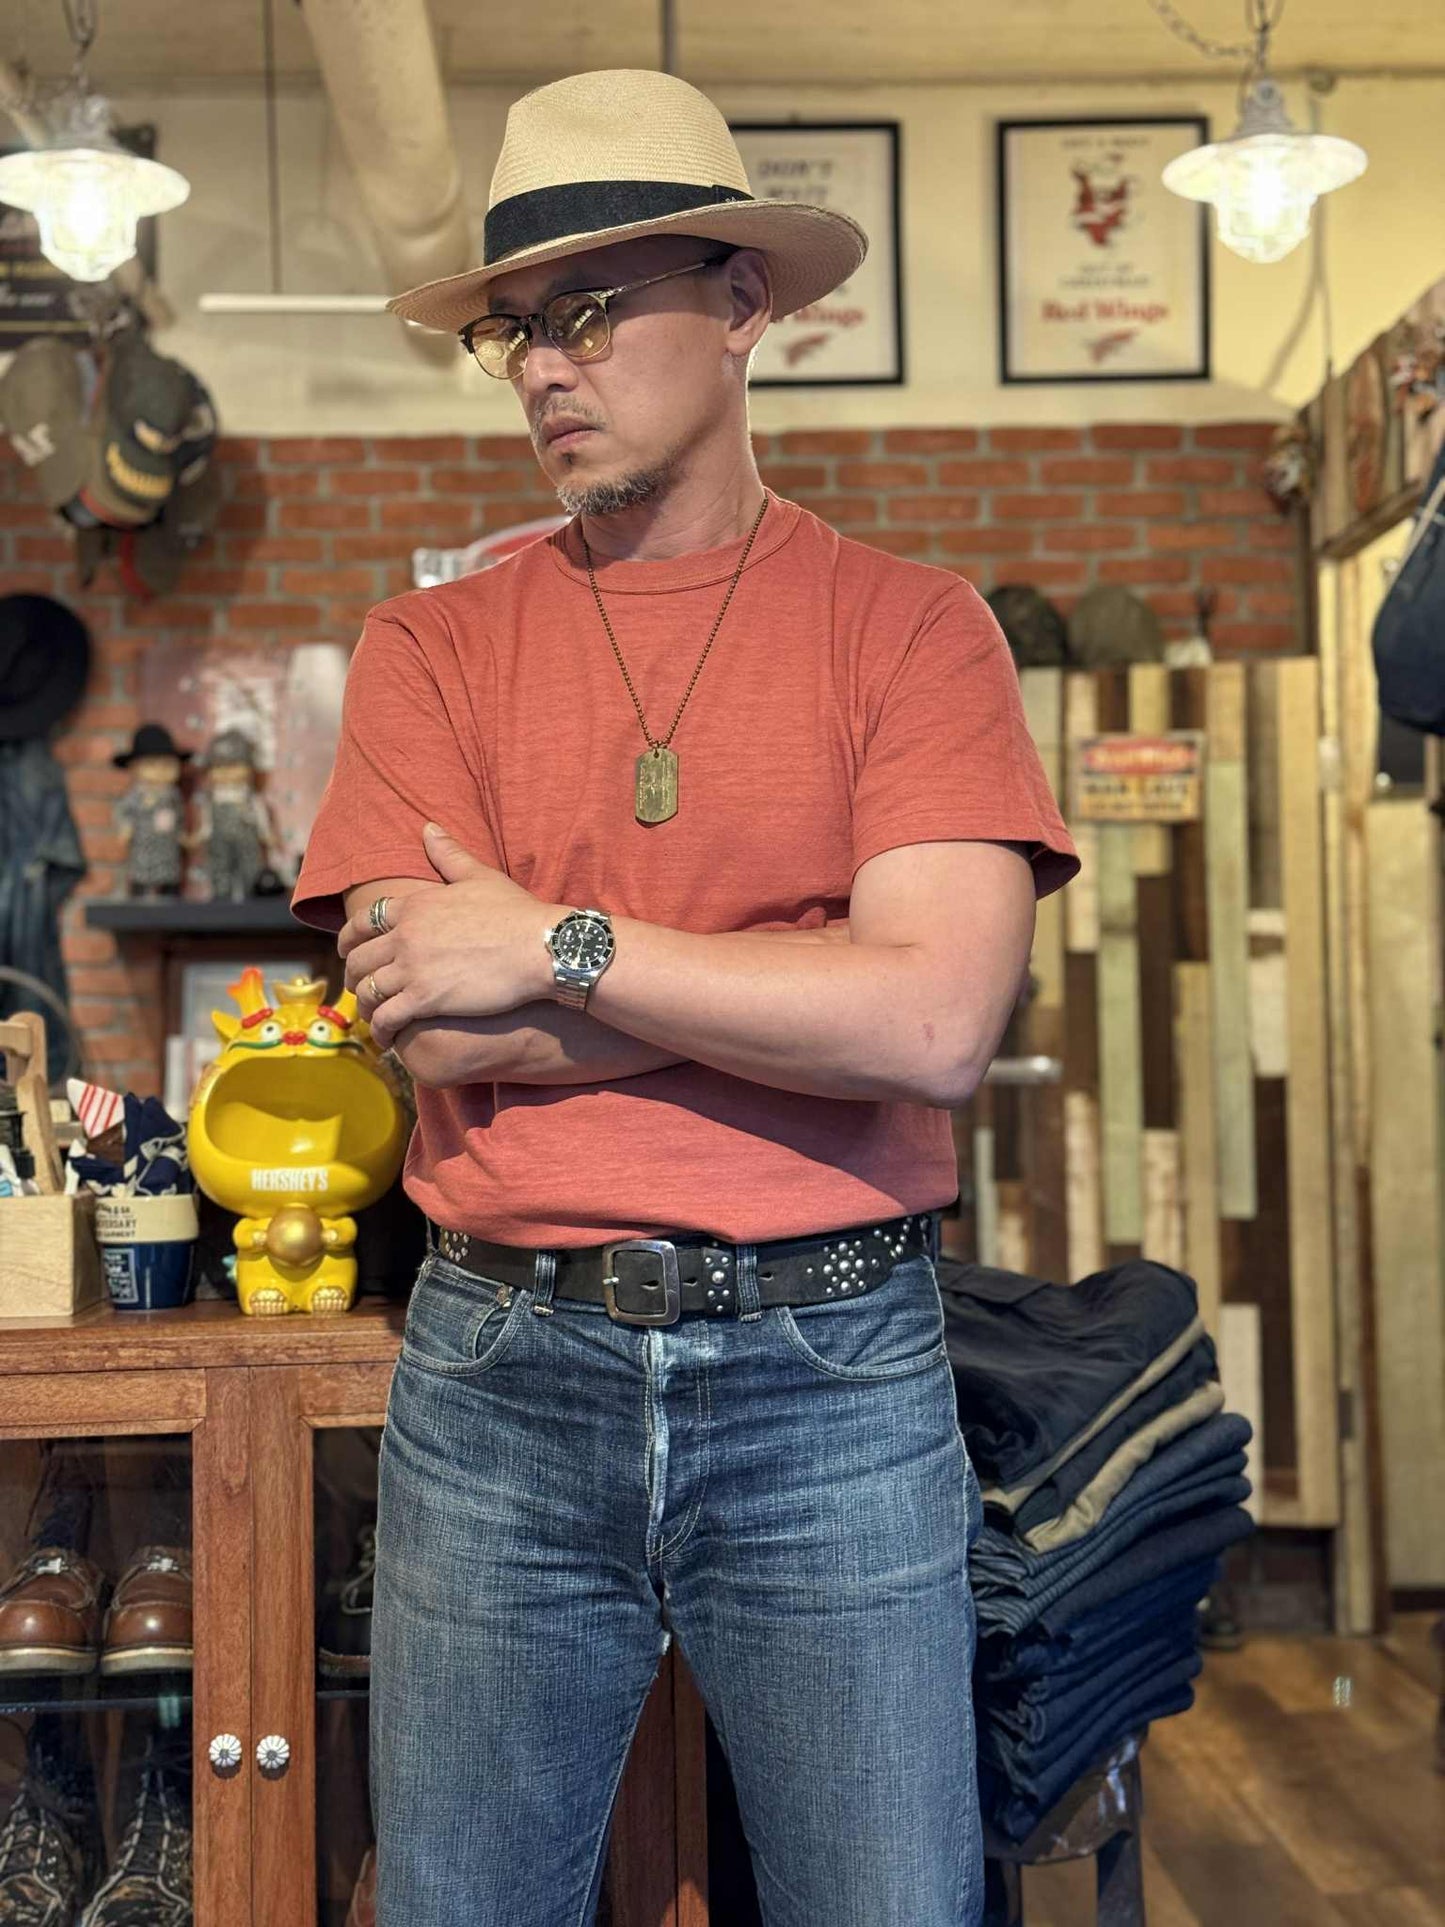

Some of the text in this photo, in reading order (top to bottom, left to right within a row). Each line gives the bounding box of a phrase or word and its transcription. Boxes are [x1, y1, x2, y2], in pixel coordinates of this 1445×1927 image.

[1042, 298, 1168, 324] Red Wings
[251, 1167, 328, 1192] HERSHEY'S
